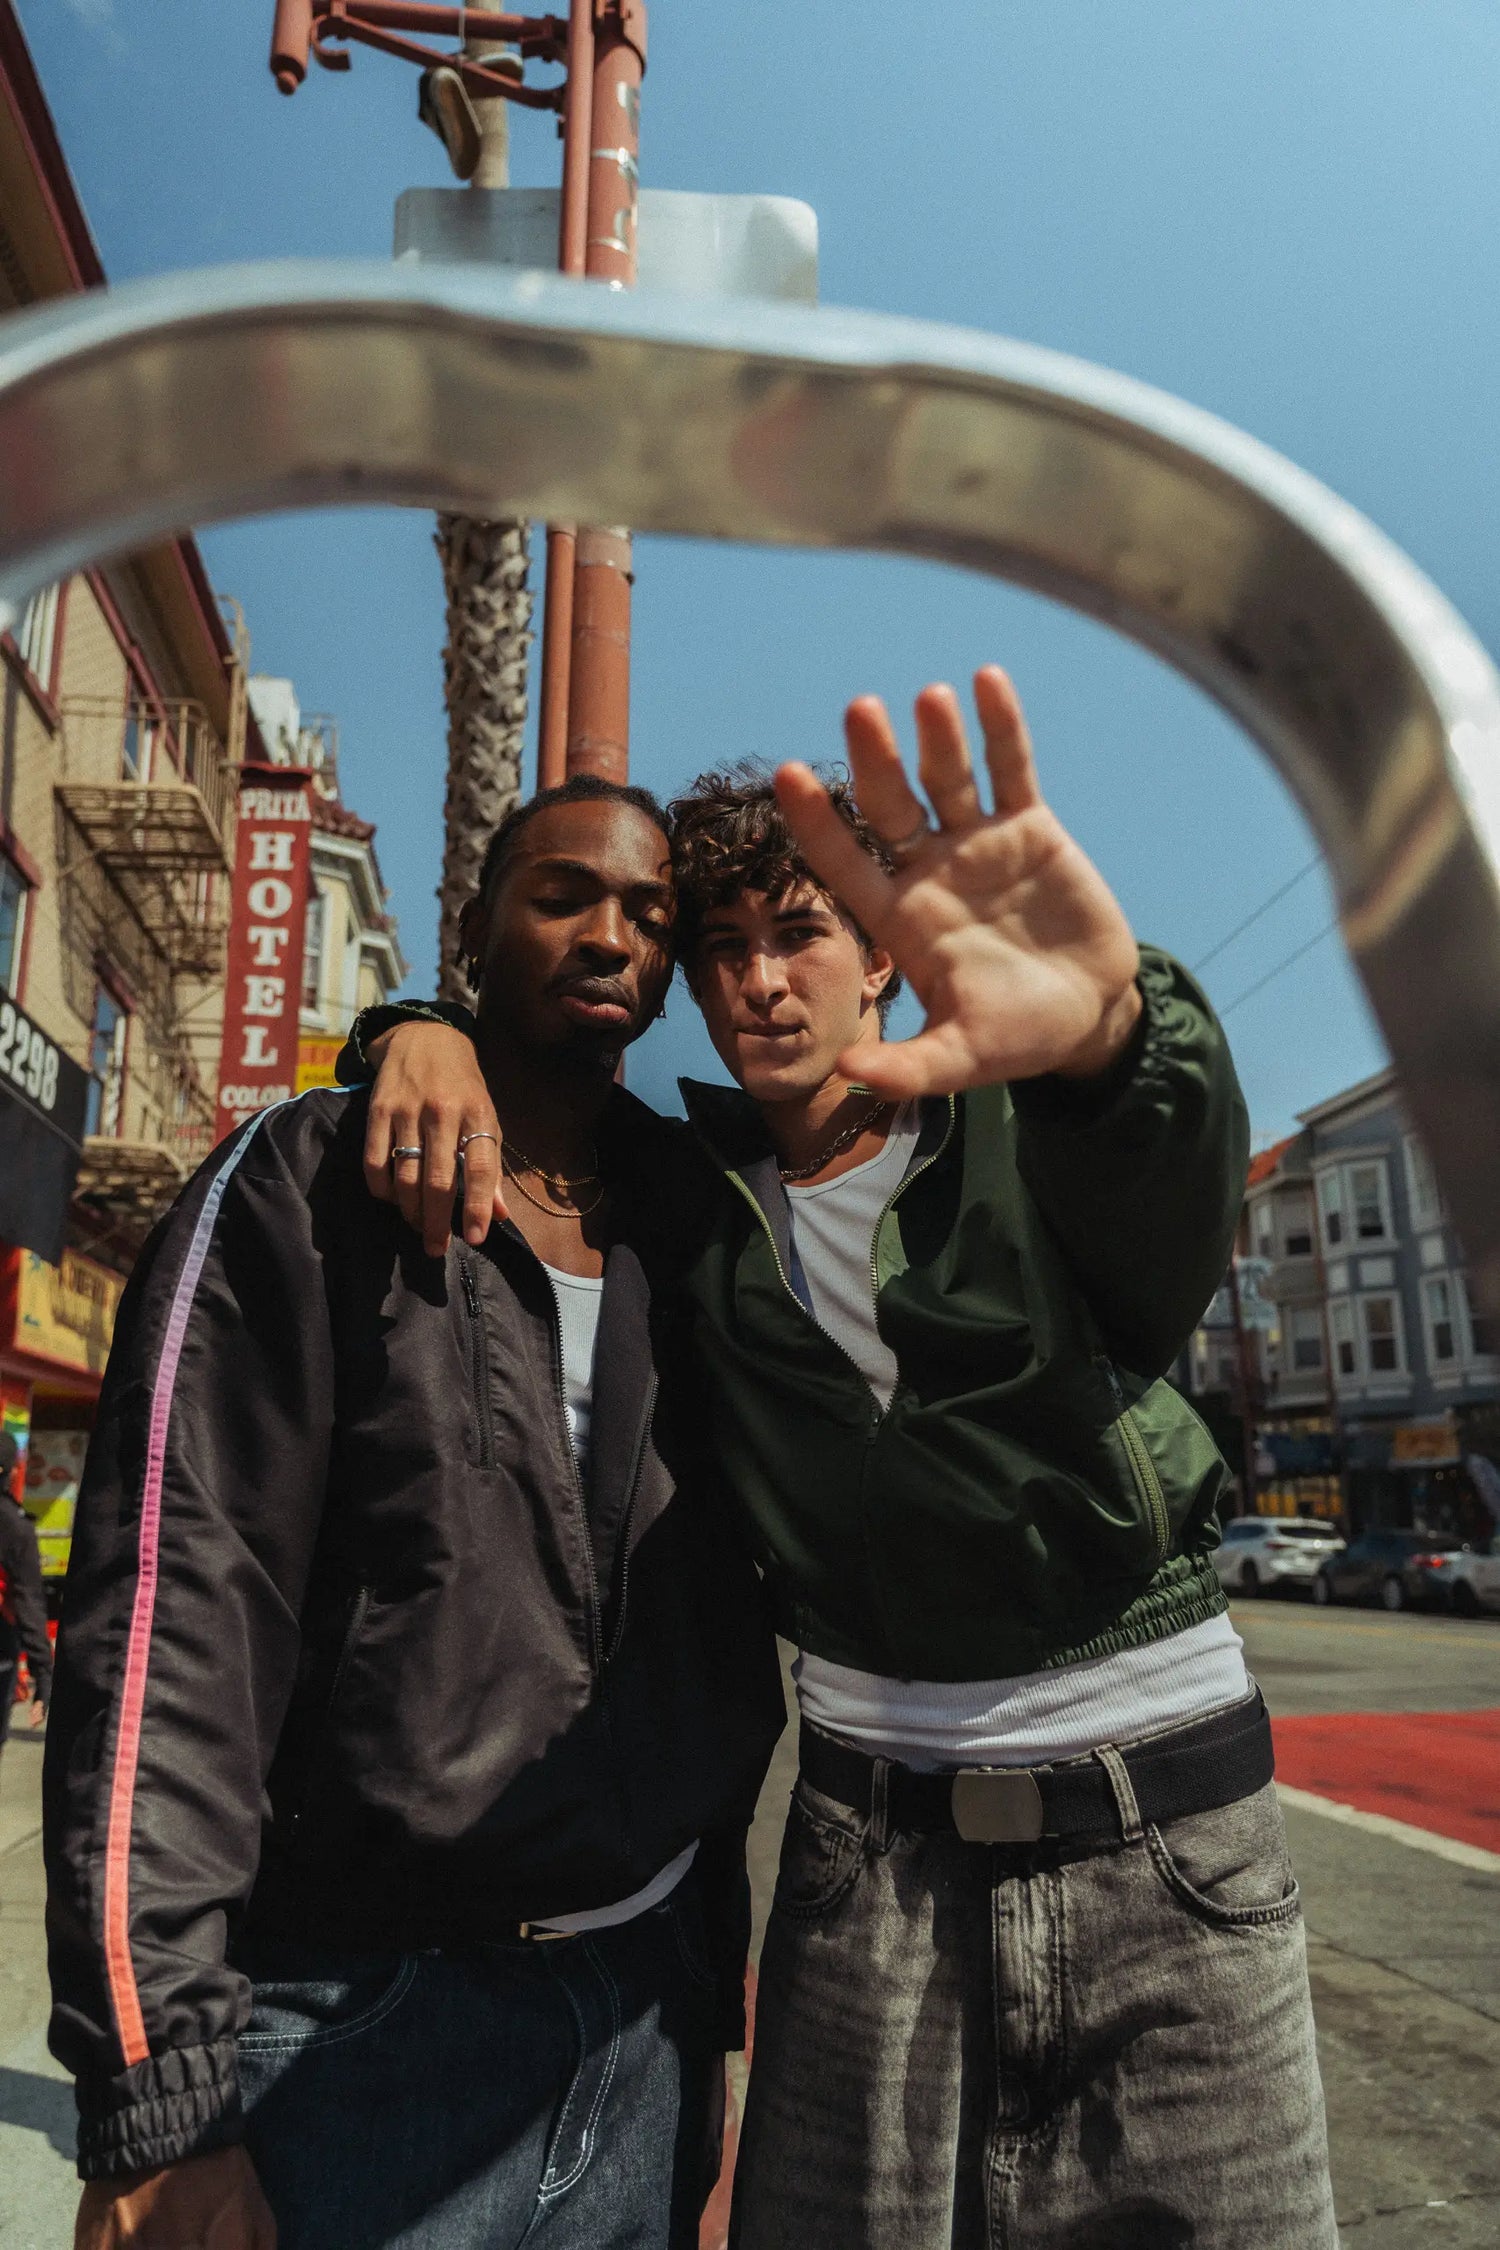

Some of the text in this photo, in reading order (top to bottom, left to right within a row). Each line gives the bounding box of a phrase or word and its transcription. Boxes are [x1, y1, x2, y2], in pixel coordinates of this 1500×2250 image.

[241, 788, 311, 820] PRITA
[240, 831, 296, 1067] HOTEL
[0, 1002, 59, 1111] 2298
